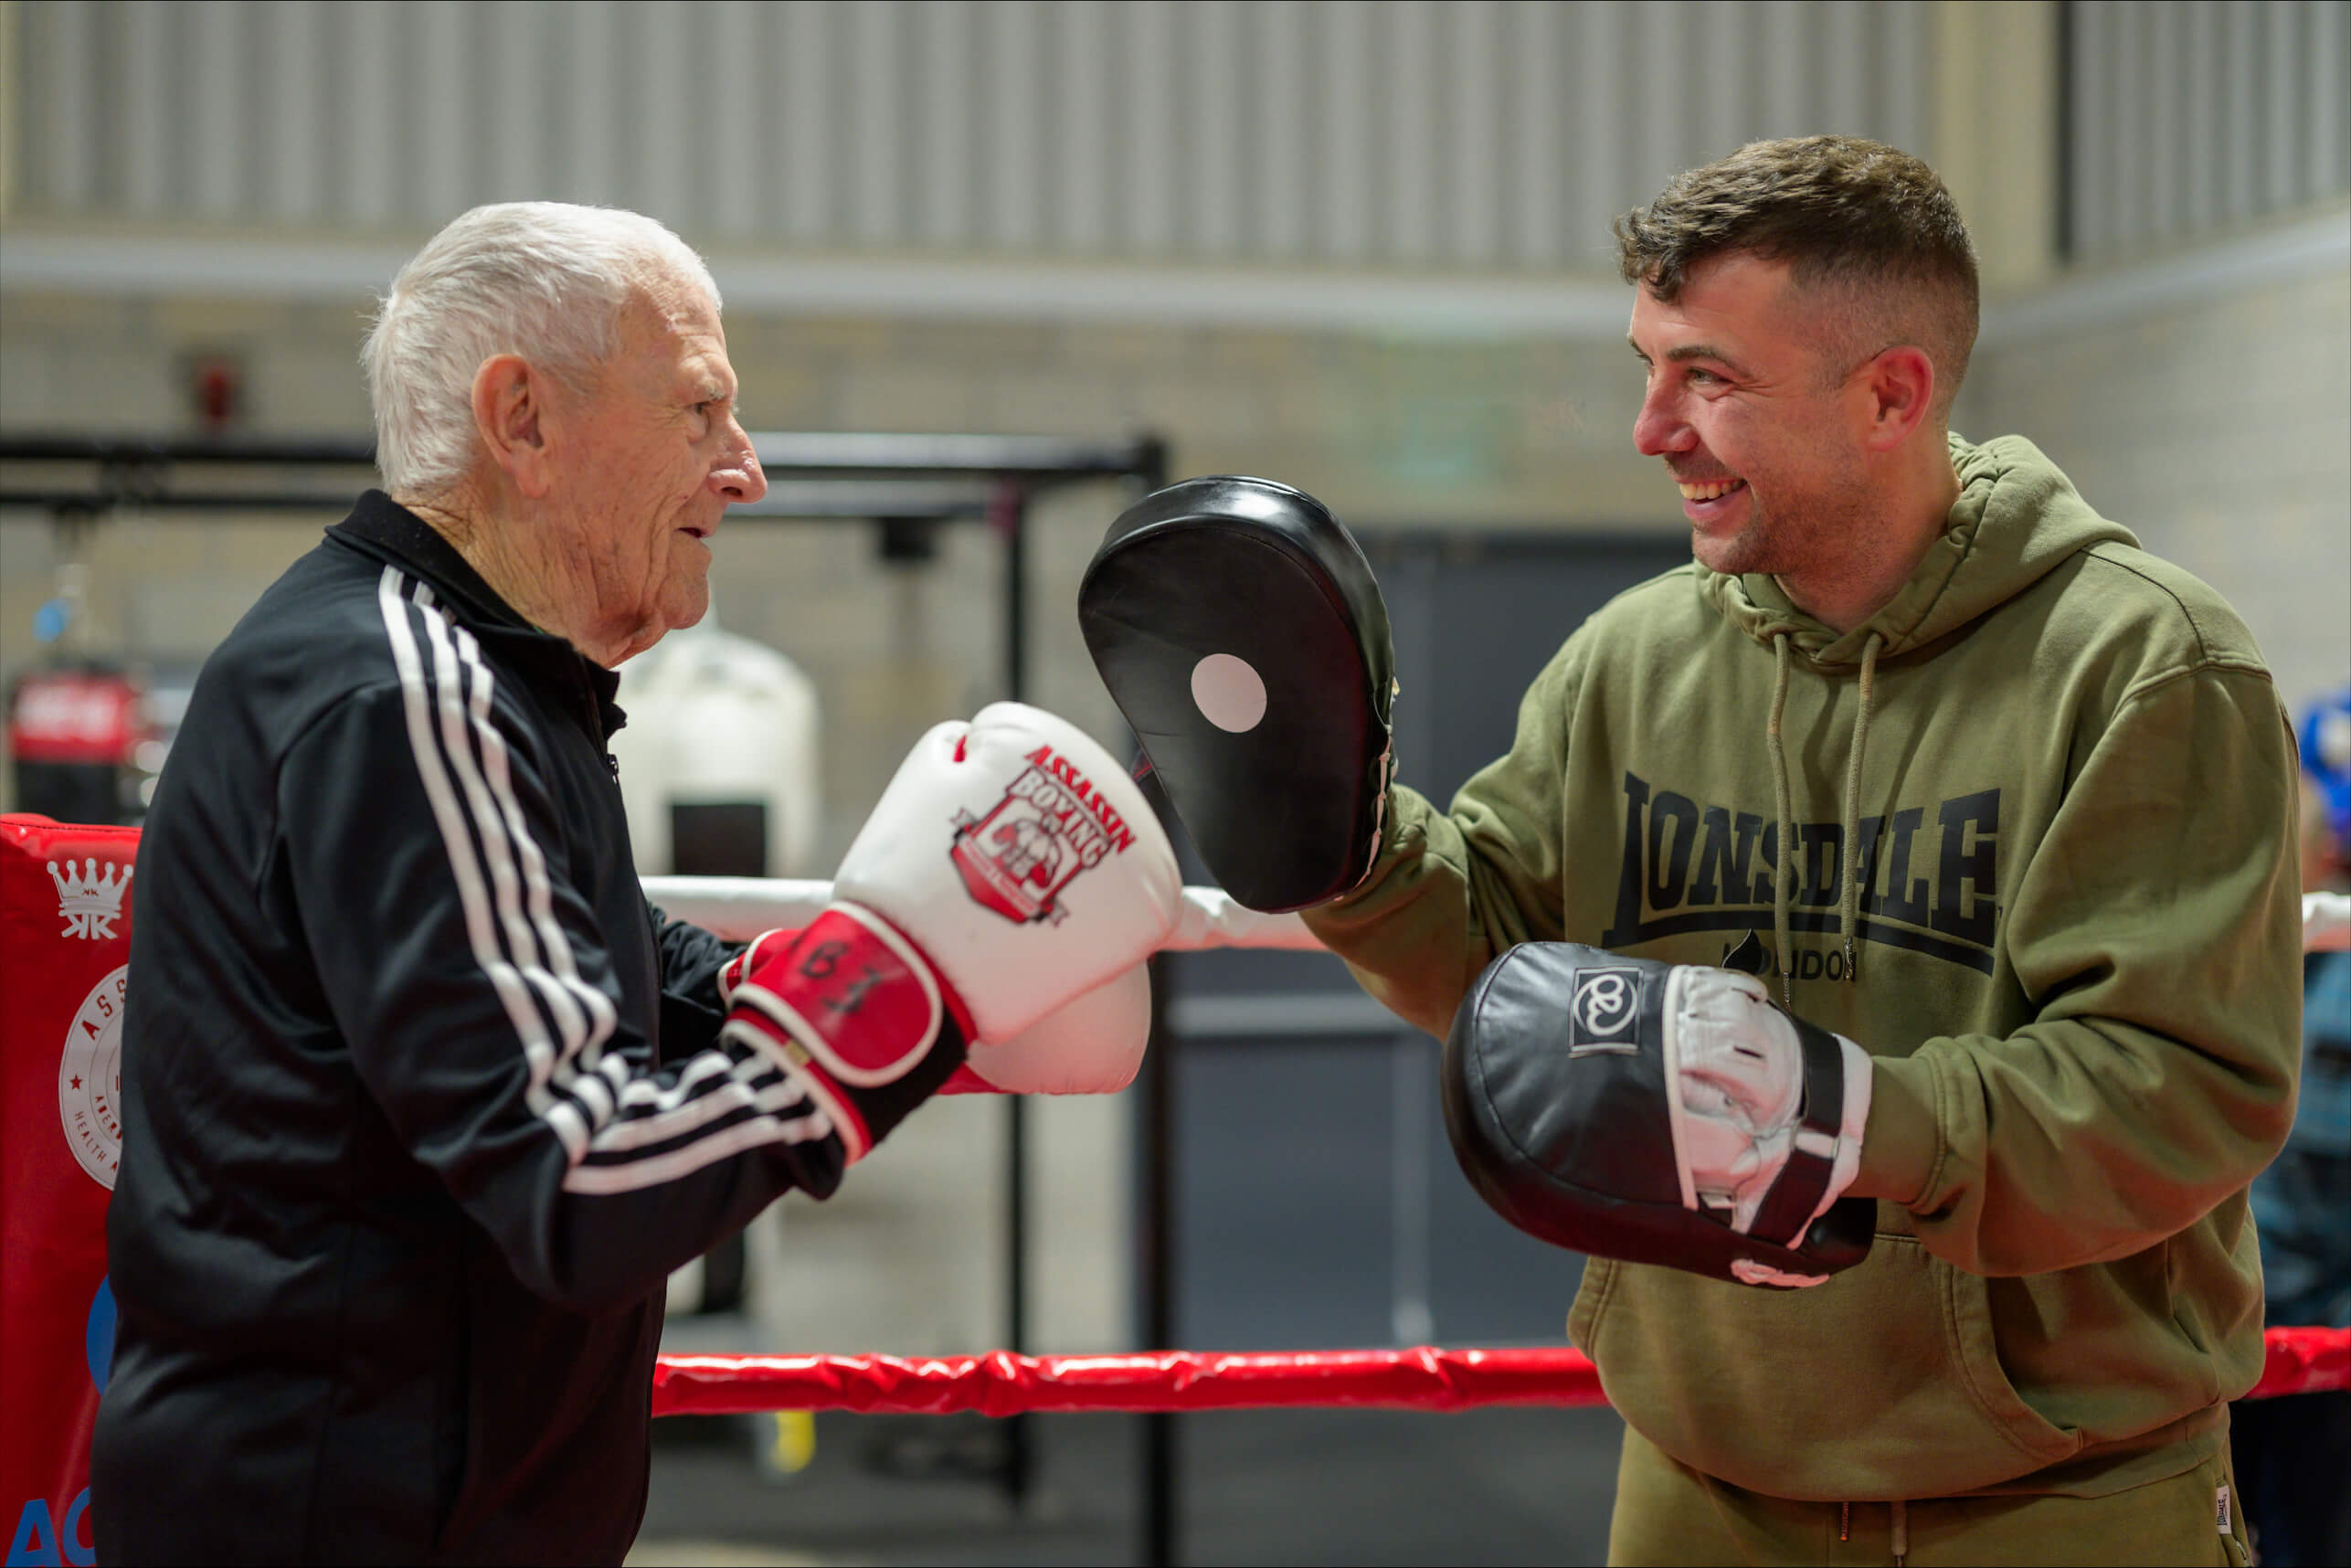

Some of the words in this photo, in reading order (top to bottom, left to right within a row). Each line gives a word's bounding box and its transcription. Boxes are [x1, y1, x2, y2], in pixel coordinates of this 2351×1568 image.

[1008, 770, 1108, 869] BOXING
[1022, 744, 1137, 855] ASSASSIN
[1603, 770, 2000, 948] LONSDALE
[1722, 943, 1857, 981] NDON
[74, 1111, 107, 1162] HEALTH
